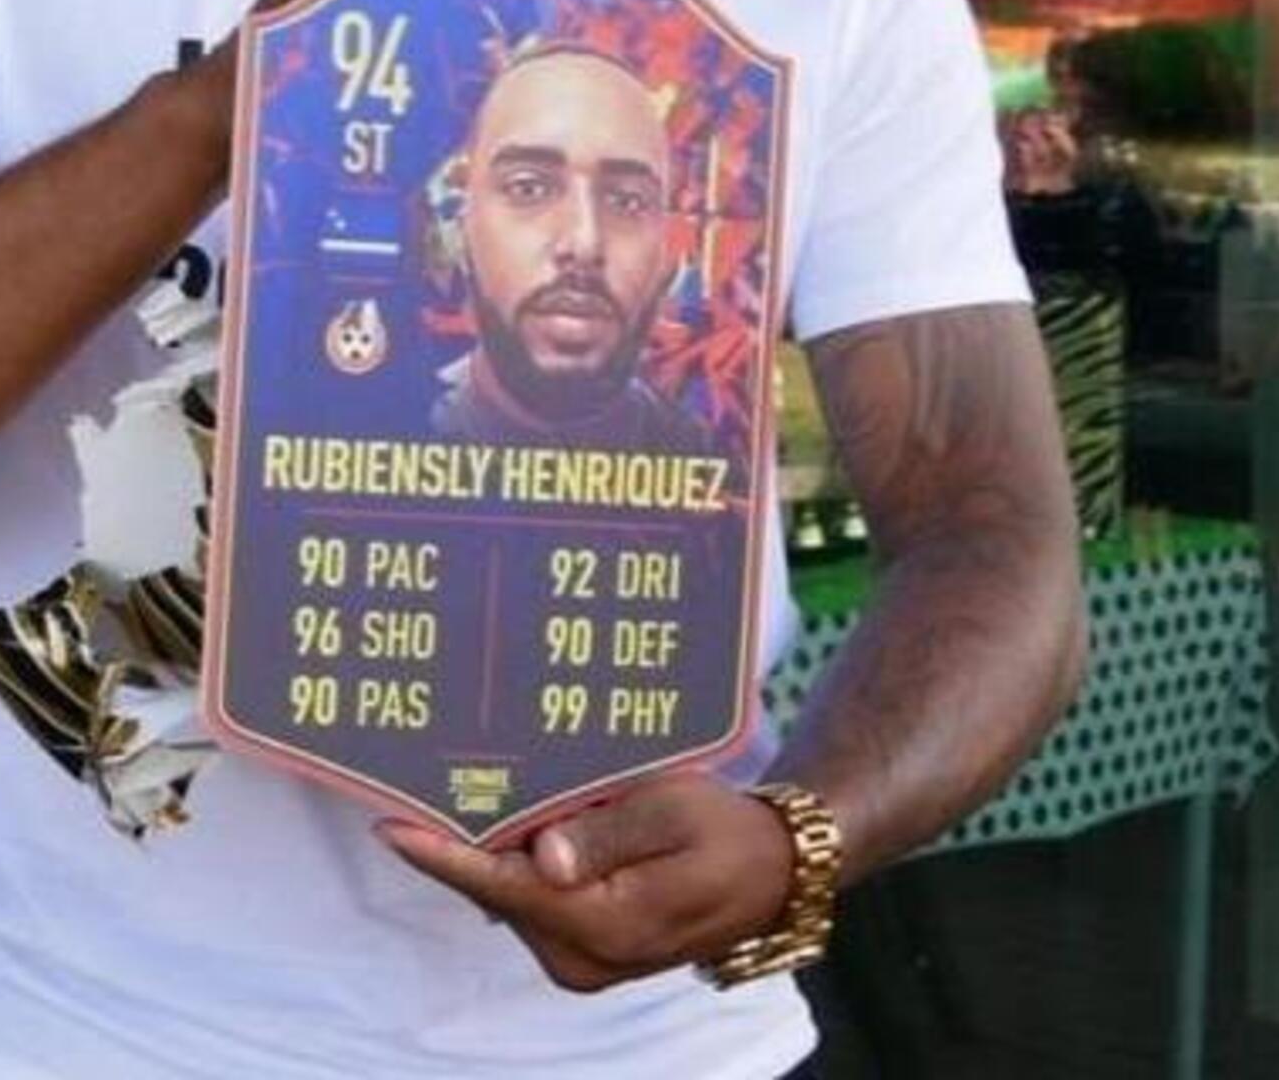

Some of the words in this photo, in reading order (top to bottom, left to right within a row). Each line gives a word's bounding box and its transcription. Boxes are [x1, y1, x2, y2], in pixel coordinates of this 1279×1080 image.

[331, 10, 413, 116] 94
[342, 121, 394, 174] ST
[263, 434, 495, 501] RUBIENSLY
[501, 447, 729, 512] HENRIQUEZ
[298, 536, 346, 588] 90
[366, 543, 441, 592] PAC
[549, 548, 597, 599] 92
[617, 551, 681, 601] DRI
[294, 606, 342, 659] 96
[360, 612, 437, 661] SHO
[545, 616, 592, 667] 90
[613, 620, 679, 669] DEF
[290, 675, 339, 727] 90
[356, 679, 432, 729] PAS
[541, 684, 590, 736] 99
[607, 688, 680, 738] PHY
